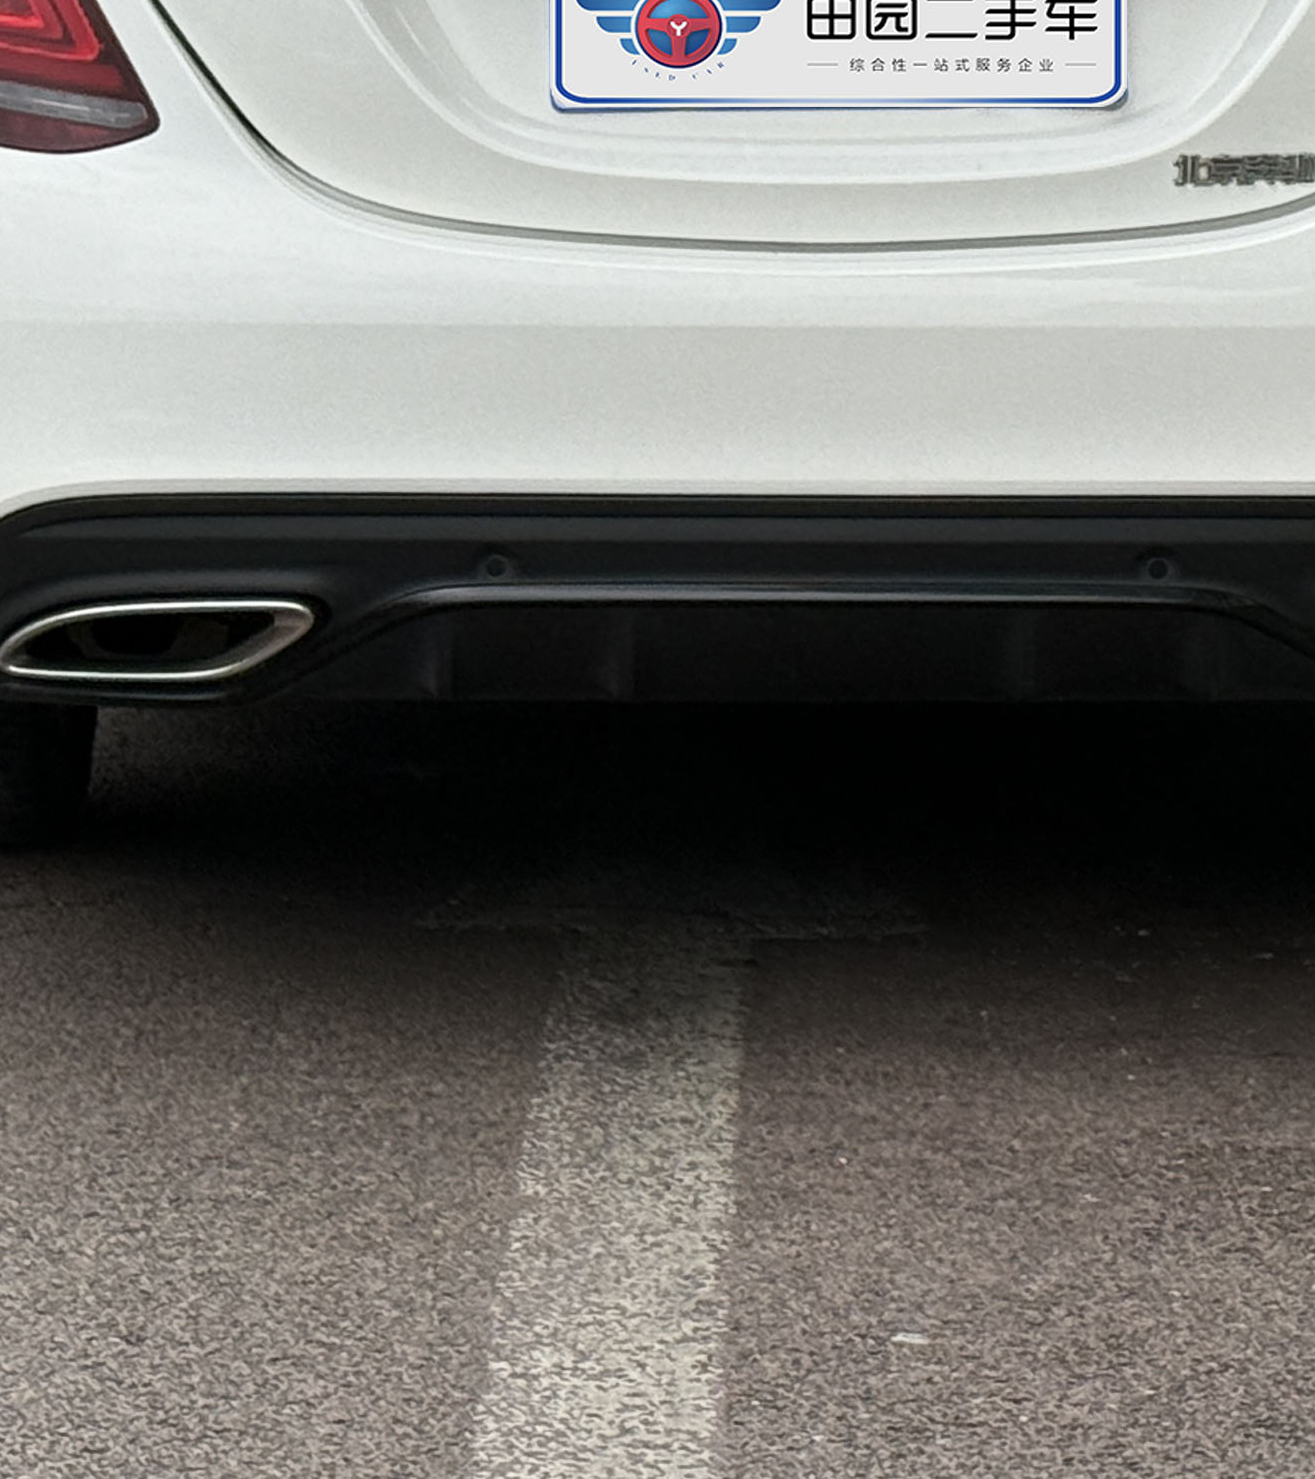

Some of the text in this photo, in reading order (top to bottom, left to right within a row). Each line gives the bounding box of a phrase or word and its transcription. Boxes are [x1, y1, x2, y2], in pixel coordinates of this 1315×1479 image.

[849, 57, 1055, 73] 综合性一站式服务企业
